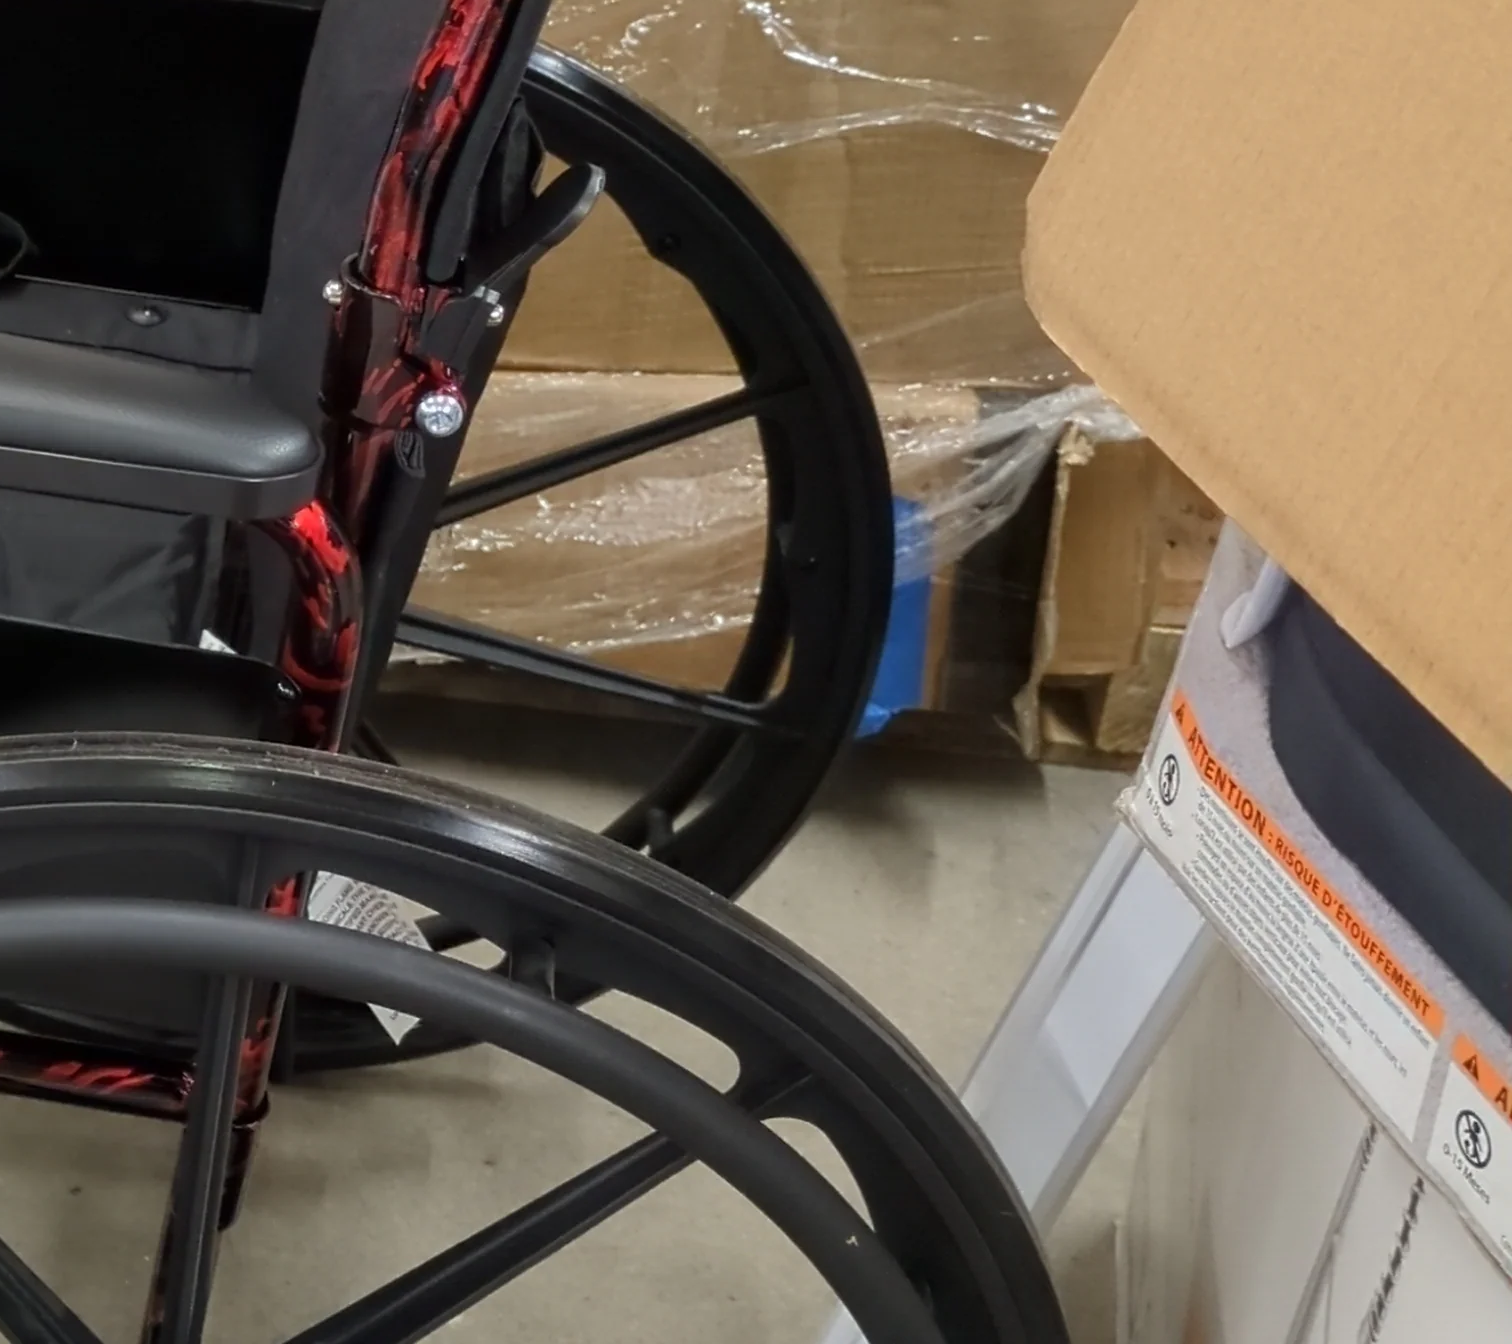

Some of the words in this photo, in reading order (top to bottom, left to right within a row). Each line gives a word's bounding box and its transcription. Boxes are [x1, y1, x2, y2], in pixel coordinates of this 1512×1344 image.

[1188, 726, 1266, 836] ATTENTION
[1274, 837, 1321, 896] RISQUE
[1321, 890, 1430, 1016] D'ÉTOUFFEMENT
[1463, 1167, 1491, 1205] Meses
